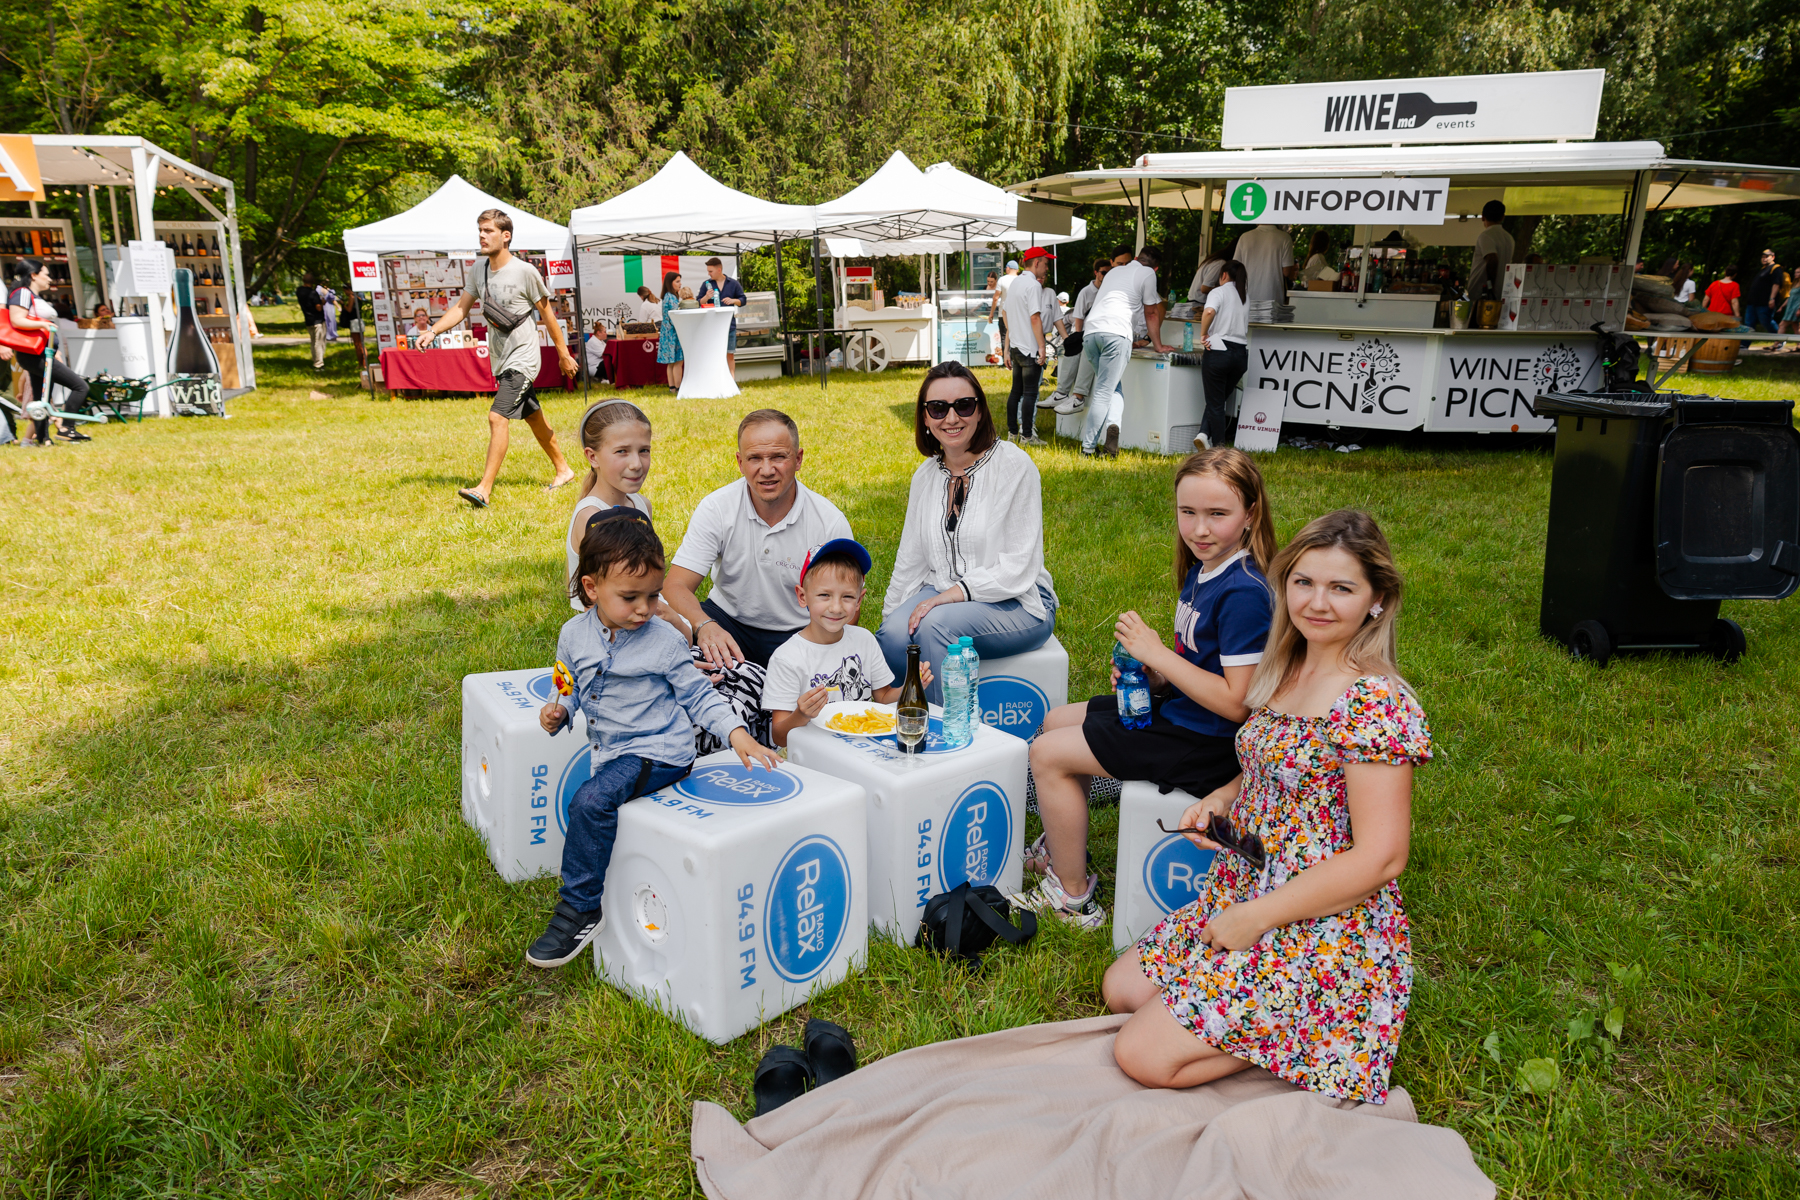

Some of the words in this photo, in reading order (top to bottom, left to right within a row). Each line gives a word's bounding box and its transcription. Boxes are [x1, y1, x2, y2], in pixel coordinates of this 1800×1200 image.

[1324, 93, 1395, 132] WINE
[1396, 115, 1417, 128] md
[1436, 119, 1476, 129] events
[1273, 189, 1443, 212] INFOPOINT
[550, 265, 573, 274] RONA
[581, 307, 613, 316] WINE
[1258, 348, 1345, 375] WINE
[1449, 357, 1532, 381] WINE
[168, 382, 222, 405] Wild
[1445, 387, 1588, 418] PICN
[496, 681, 522, 696] 94.9
[515, 698, 534, 709] FM
[1005, 701, 1034, 709] RADIO
[831, 733, 871, 749] 94.9
[531, 764, 549, 809] 94.9
[696, 769, 772, 798] Relax
[751, 779, 781, 792] RADIO
[677, 804, 715, 819] FM
[530, 815, 547, 845] FM
[917, 818, 932, 869] 94.9
[965, 801, 989, 883] Relax
[980, 847, 989, 881] RADIO
[916, 873, 931, 908] FM
[737, 883, 756, 942] 94.9
[795, 858, 824, 959] Relax
[815, 911, 825, 951] RADIO
[739, 947, 757, 990] FM
